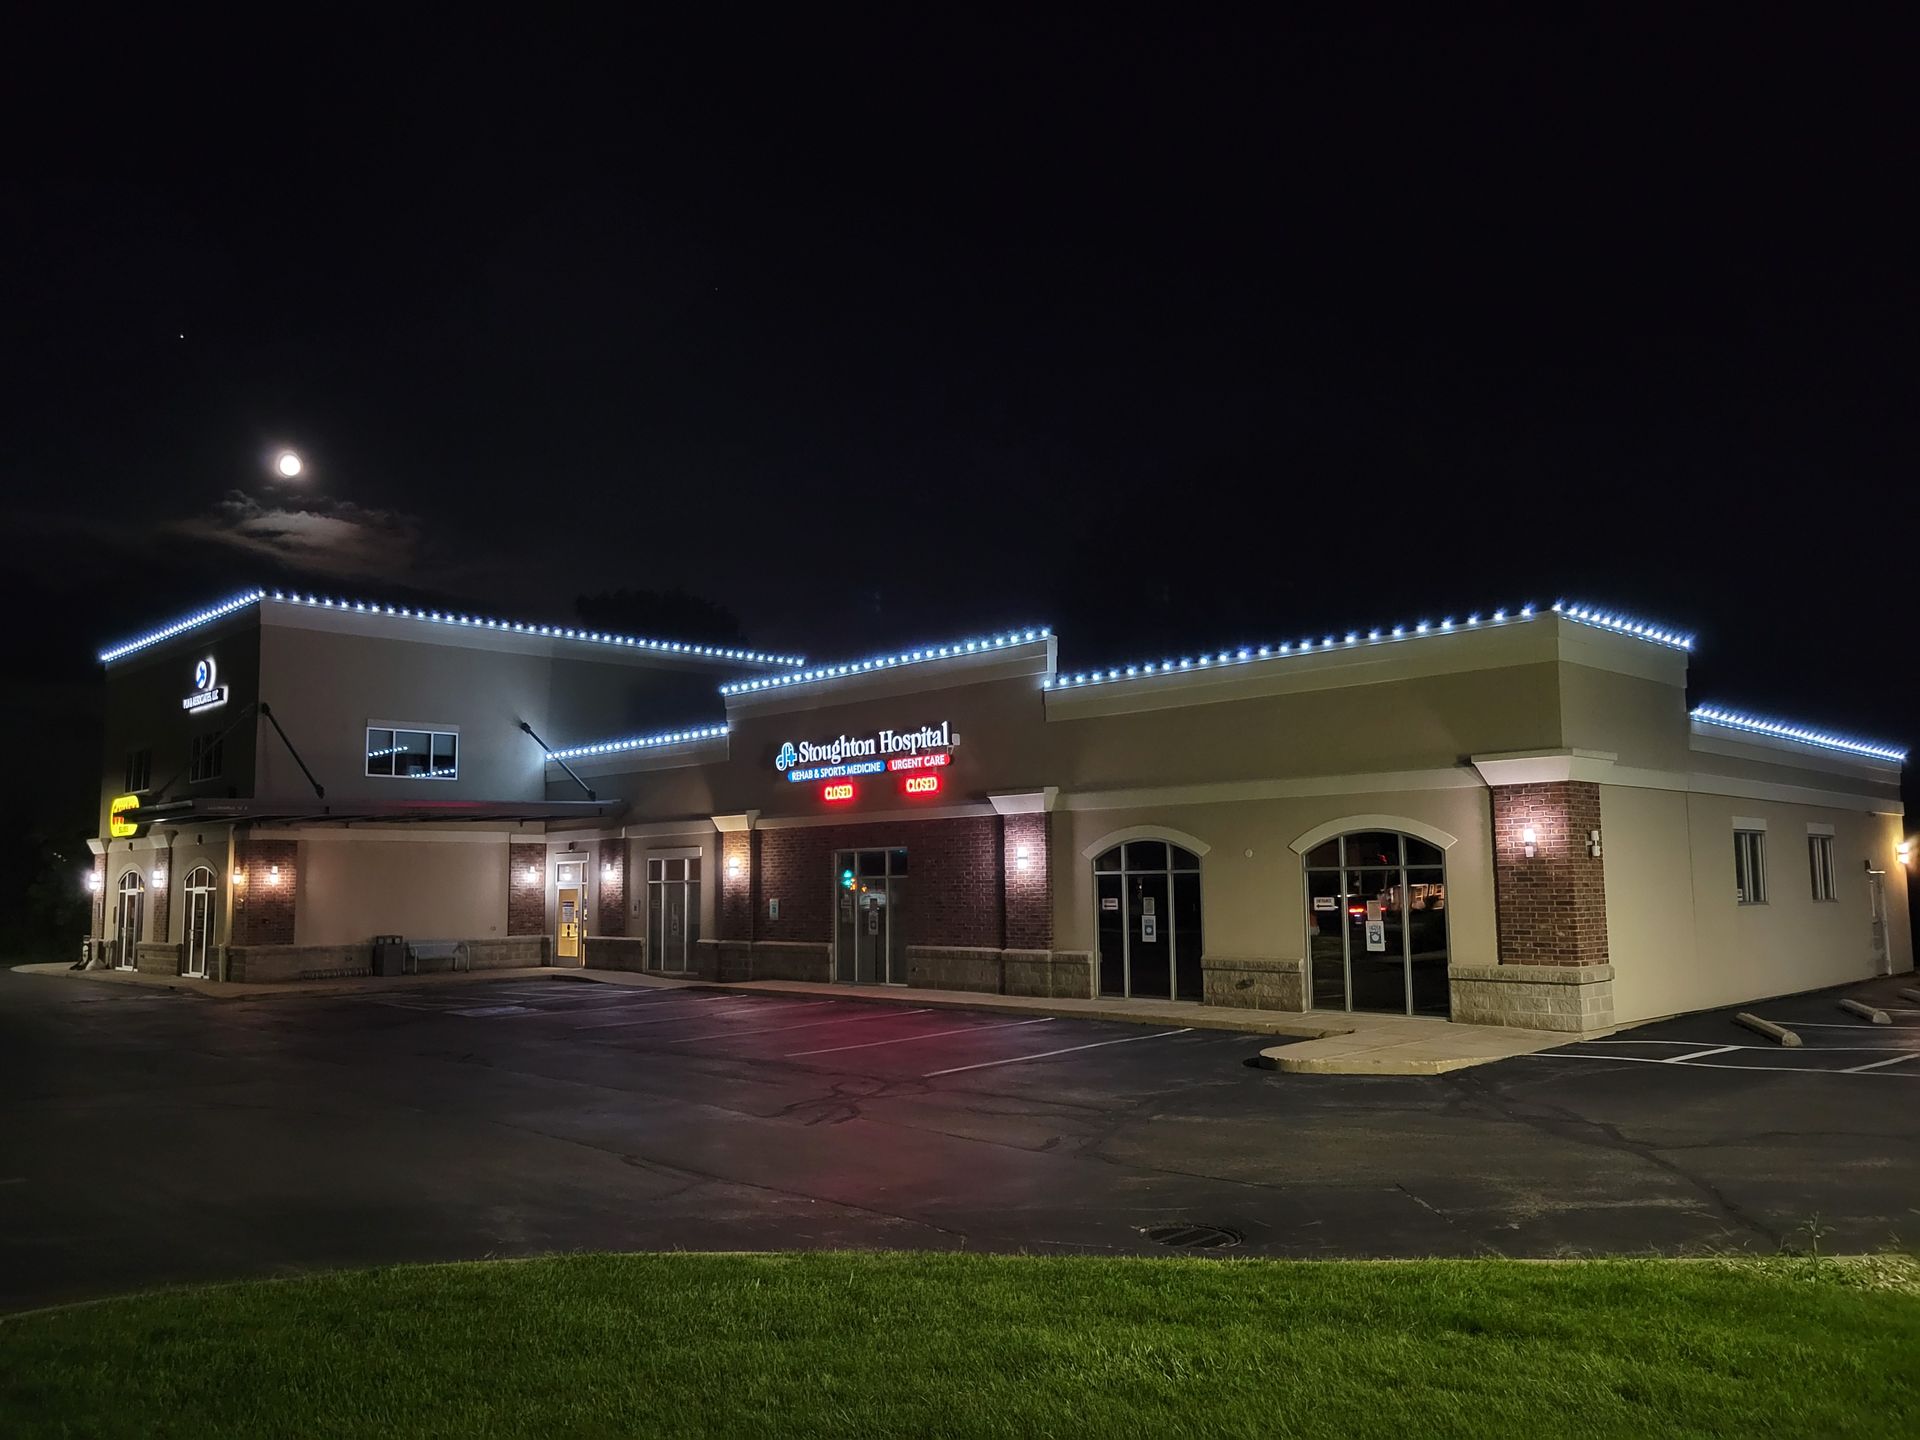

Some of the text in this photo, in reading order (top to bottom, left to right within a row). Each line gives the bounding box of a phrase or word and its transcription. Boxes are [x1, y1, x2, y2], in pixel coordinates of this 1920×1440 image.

[799, 720, 949, 764] Stoughton Hospital
[791, 762, 881, 781] REHAB & SPORTS MEDICINE
[891, 755, 945, 771] URGENT CARE
[824, 785, 853, 800] CLOSED
[905, 776, 938, 793] CLOSED
